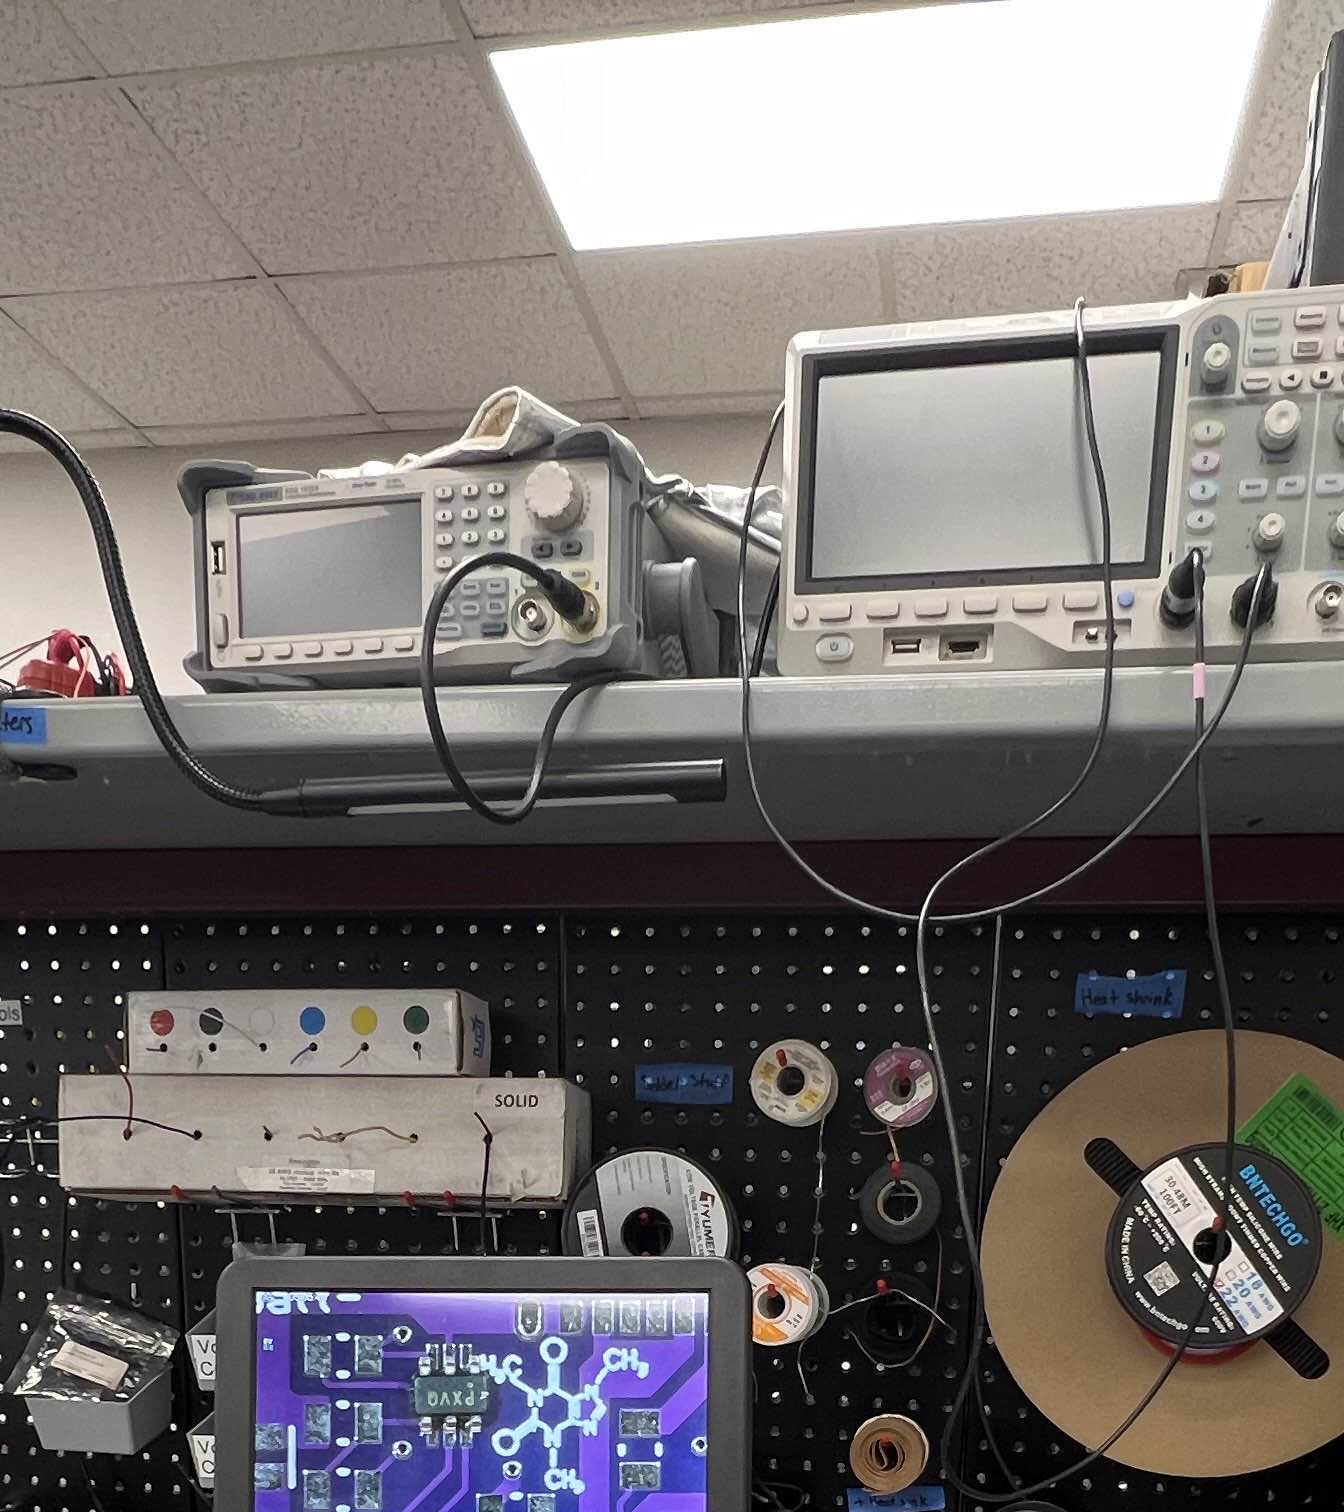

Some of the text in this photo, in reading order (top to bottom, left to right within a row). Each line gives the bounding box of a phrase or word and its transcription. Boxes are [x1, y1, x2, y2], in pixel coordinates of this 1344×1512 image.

[494, 1094, 539, 1108] SOLID
[1157, 1187, 1183, 1217] 100FT
[1162, 1174, 1193, 1211] 30.48M
[1239, 1163, 1304, 1247] BNTECHGO
[1121, 1217, 1135, 1244] MADE
[1256, 1247, 1280, 1276] COPPER
